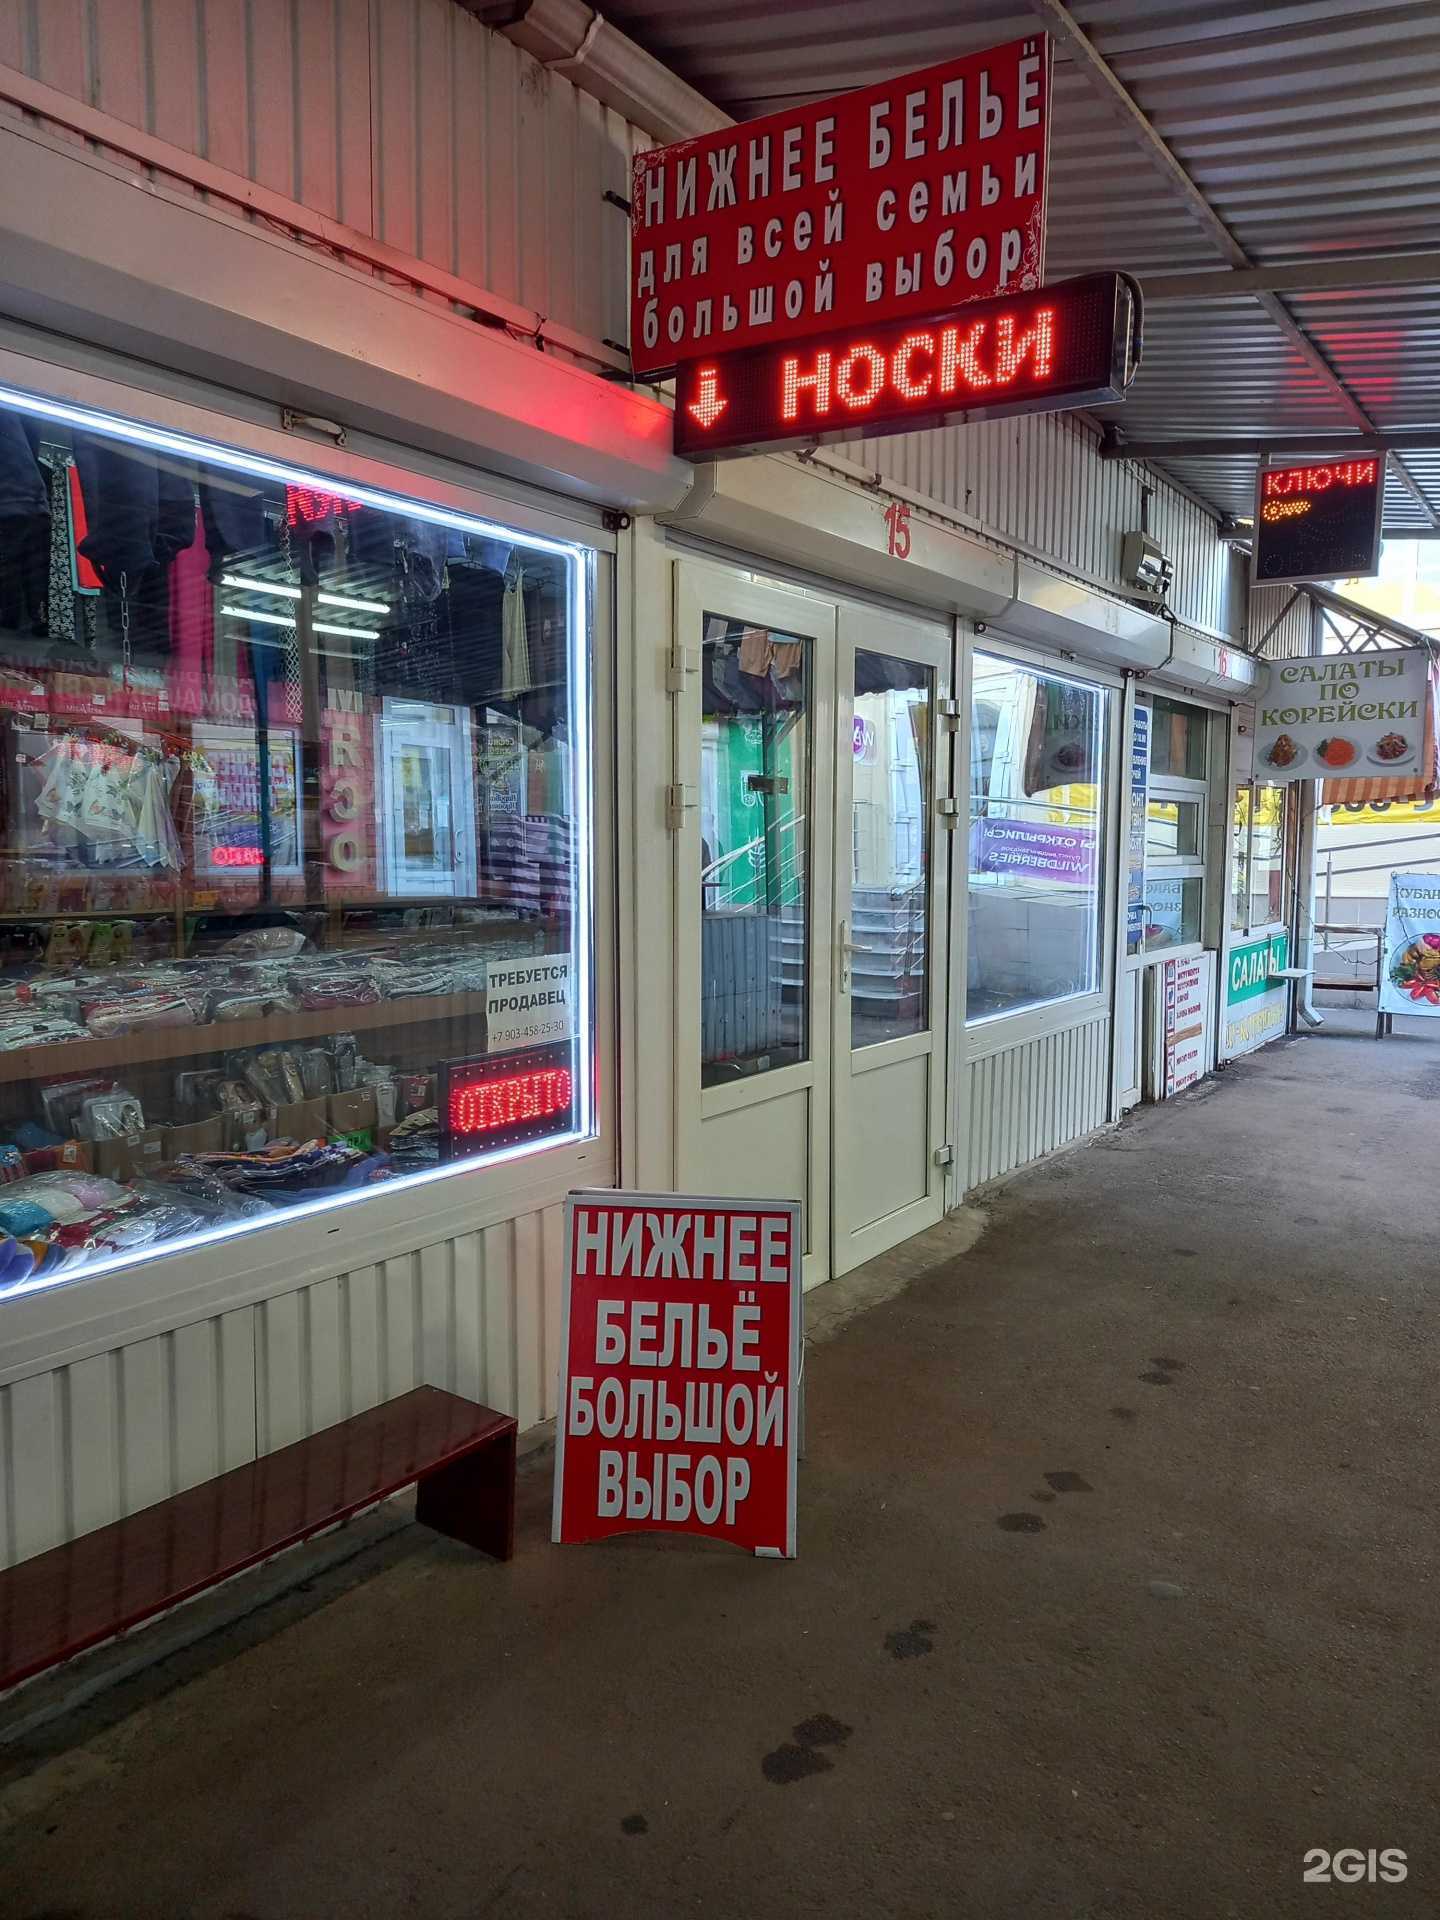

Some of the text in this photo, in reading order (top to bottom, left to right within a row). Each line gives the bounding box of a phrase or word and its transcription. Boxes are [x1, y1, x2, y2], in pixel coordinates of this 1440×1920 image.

[645, 42, 1040, 228] НИЖНЕЕ БЕЛЬЁ
[637, 152, 1036, 298] для всей семьи
[642, 227, 1022, 349] большой выбор
[782, 308, 1055, 421] НОСКИ
[1266, 461, 1375, 496] КЛЮЧИ
[884, 502, 911, 559] 15
[1280, 658, 1406, 684] САЛАТЫ
[1319, 682, 1360, 701] ПО
[1261, 700, 1419, 727] КОРЕЙСКИ
[488, 964, 569, 989] ТРЕБУЕТСЯ
[1232, 945, 1281, 992] САЛАТЫ
[488, 989, 566, 1015] ПРОДАВЕЦ
[459, 1069, 572, 1132] ОТКРЫТО
[575, 1210, 788, 1283] НИЖНЕЕ
[595, 1290, 761, 1372] БЕЛЬЁ
[568, 1371, 784, 1447] БОЛЬШОЙ
[597, 1450, 751, 1526] ВЫБОР
